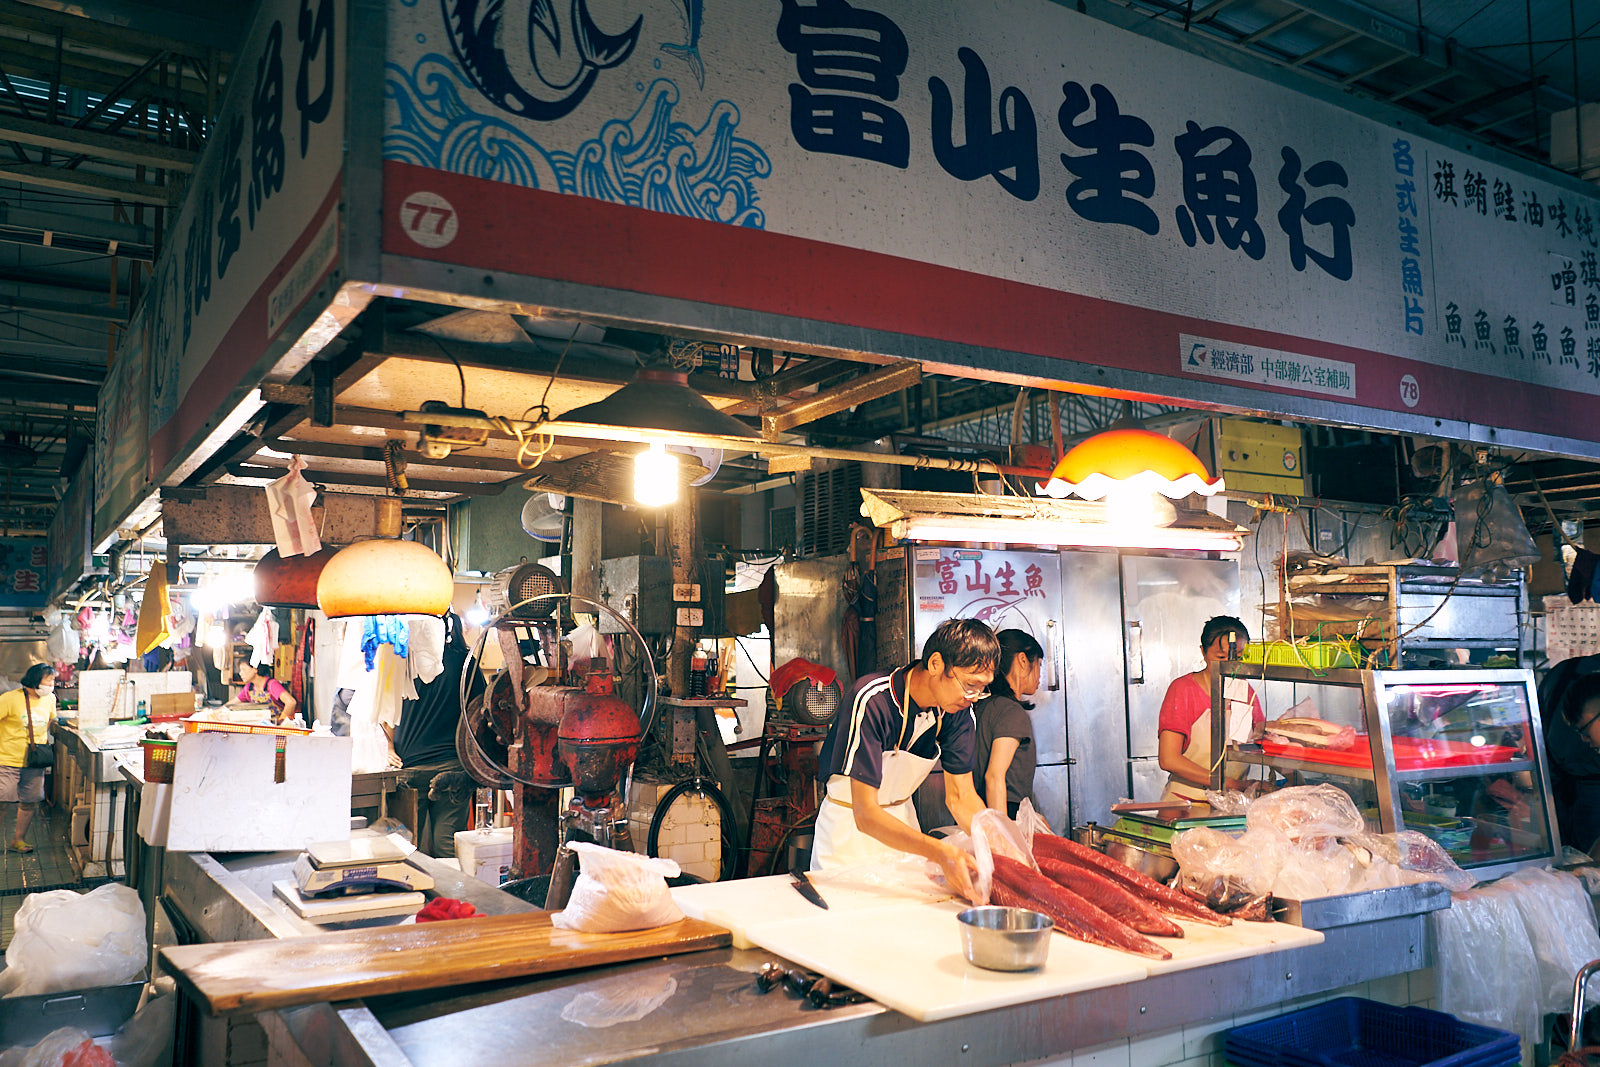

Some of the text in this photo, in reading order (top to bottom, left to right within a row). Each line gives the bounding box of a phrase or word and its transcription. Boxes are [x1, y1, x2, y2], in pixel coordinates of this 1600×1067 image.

[777, 0, 1355, 281] 富山生魚行
[405, 202, 453, 235] 77
[1392, 137, 1424, 336] 各式生魚片
[1211, 349, 1351, 390] 經濟部 中部辦公室補助
[1402, 381, 1418, 400] 78
[935, 557, 1046, 599] 富山生魚
